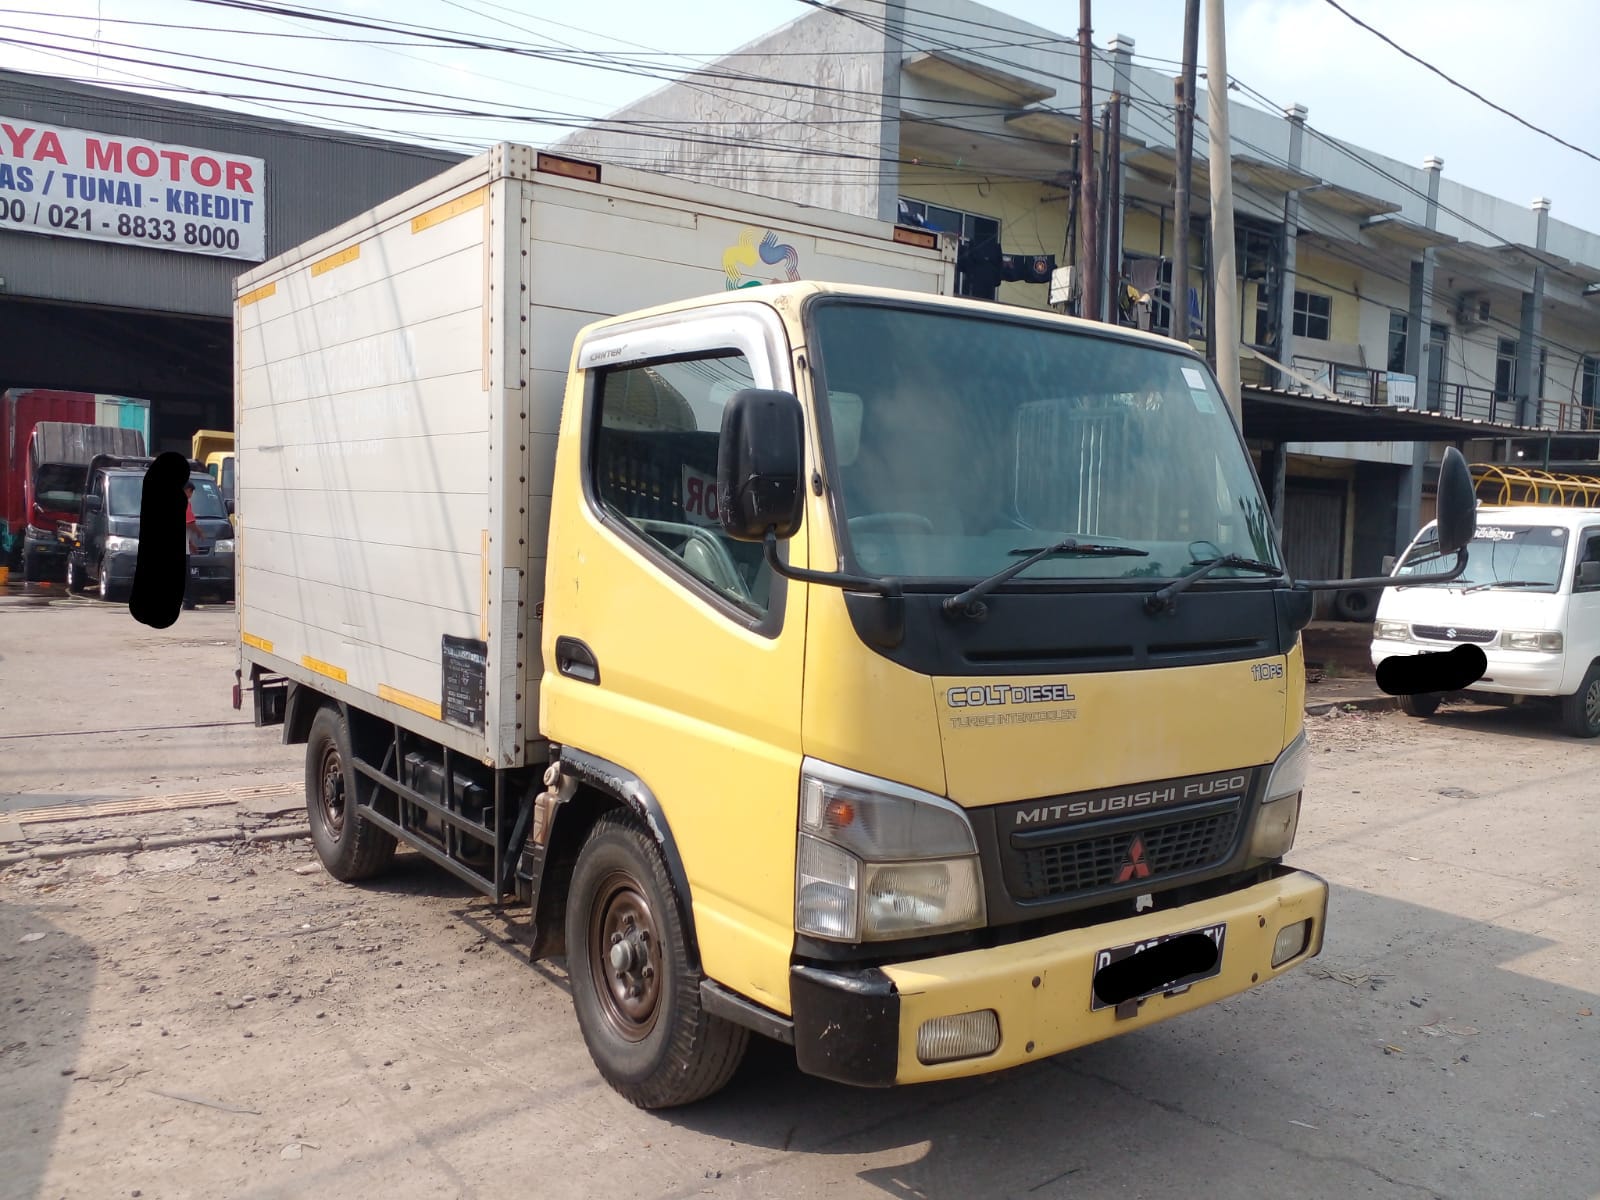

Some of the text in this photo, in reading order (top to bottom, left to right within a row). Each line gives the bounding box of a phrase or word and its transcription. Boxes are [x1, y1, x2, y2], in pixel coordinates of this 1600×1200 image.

[0, 123, 254, 193] YA MOTOR
[42, 170, 55, 195] /
[62, 173, 142, 208] TUNAI
[149, 195, 159, 203] -
[166, 188, 254, 223] KREDIT
[33, 202, 41, 225] /
[48, 204, 92, 231] 021
[117, 213, 176, 242] 8833
[184, 223, 240, 250] 8000
[1016, 776, 1245, 824] MITSUBISHI FUSO
